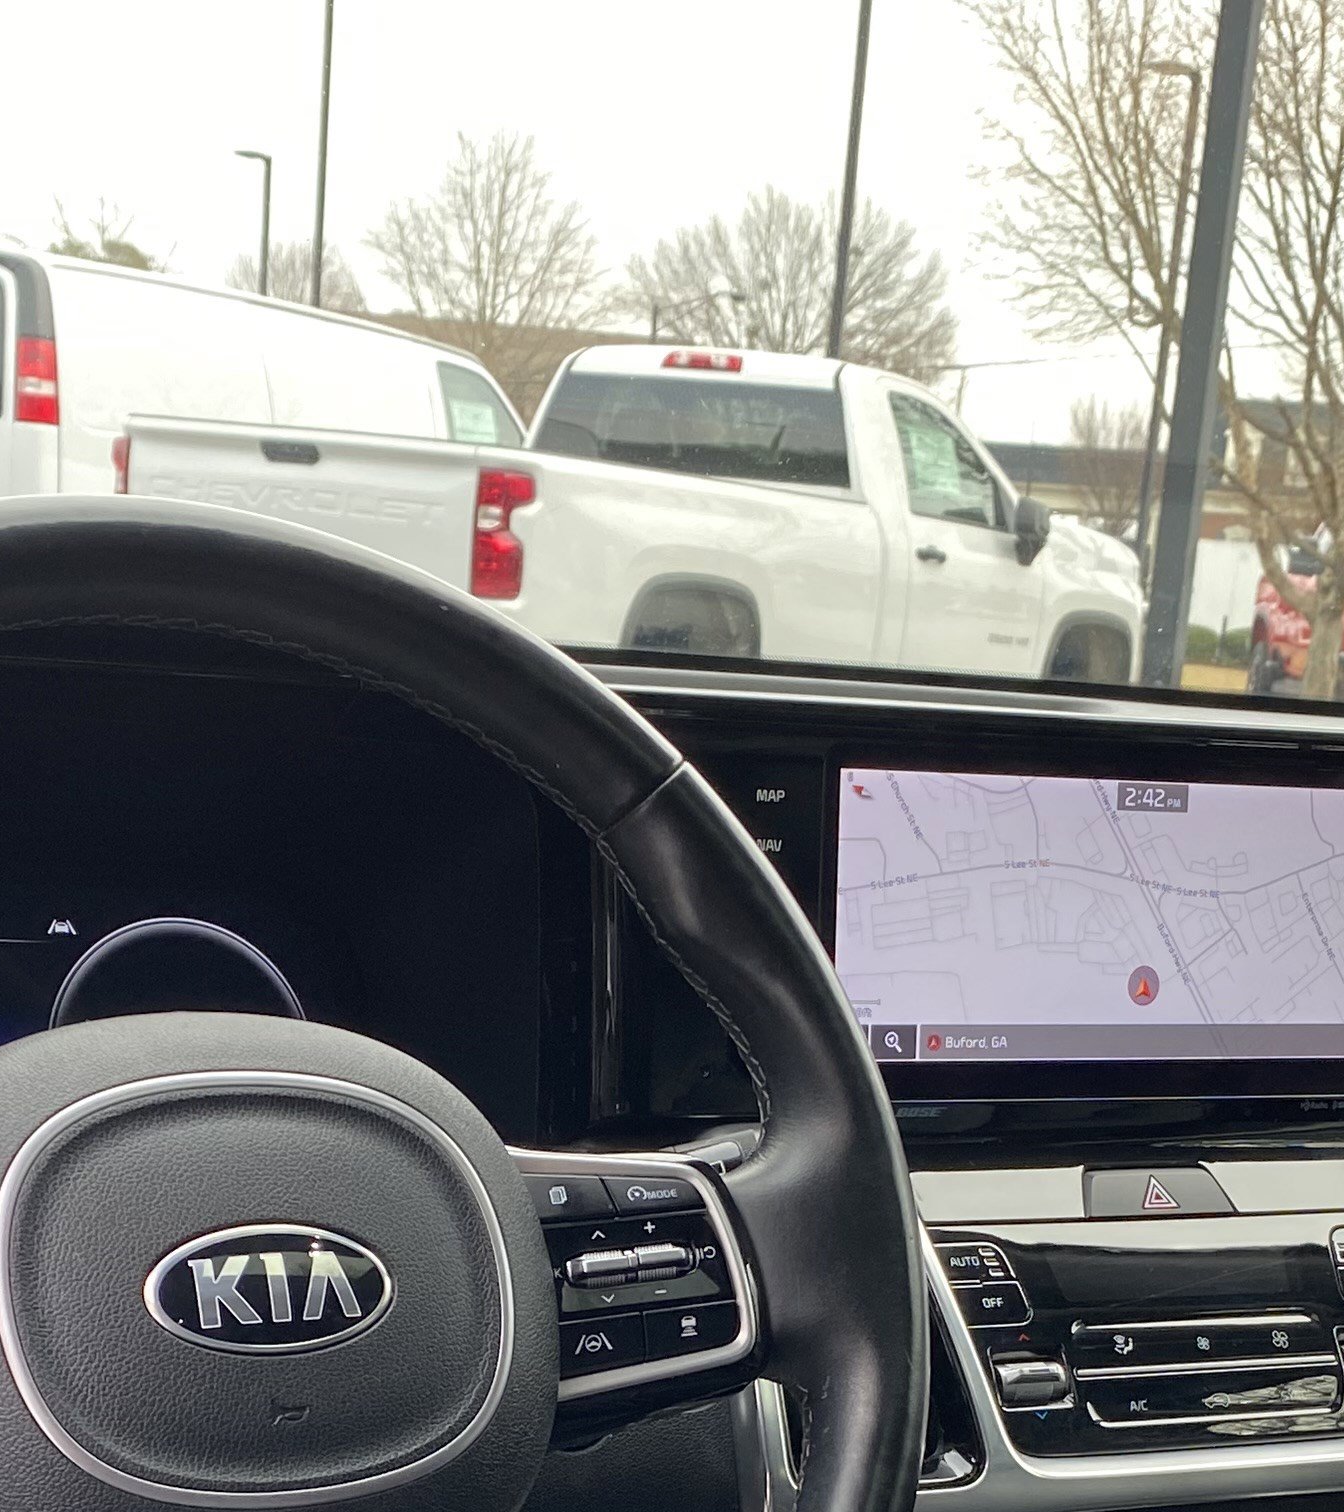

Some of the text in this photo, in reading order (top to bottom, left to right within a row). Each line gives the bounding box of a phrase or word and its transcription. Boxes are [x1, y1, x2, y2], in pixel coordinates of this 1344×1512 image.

[150, 475, 449, 526] CHEVROLET
[756, 788, 786, 803] MAP
[891, 781, 910, 815] Church
[1124, 787, 1182, 808] 2:42 PM
[756, 838, 783, 852] NAV
[945, 1036, 1008, 1050] Buford, GA
[646, 1187, 679, 1200] MODE
[950, 1256, 980, 1267] AUTO
[187, 1250, 363, 1330] KIA
[981, 1297, 1005, 1309] OFF
[1128, 1397, 1149, 1412] A/C
